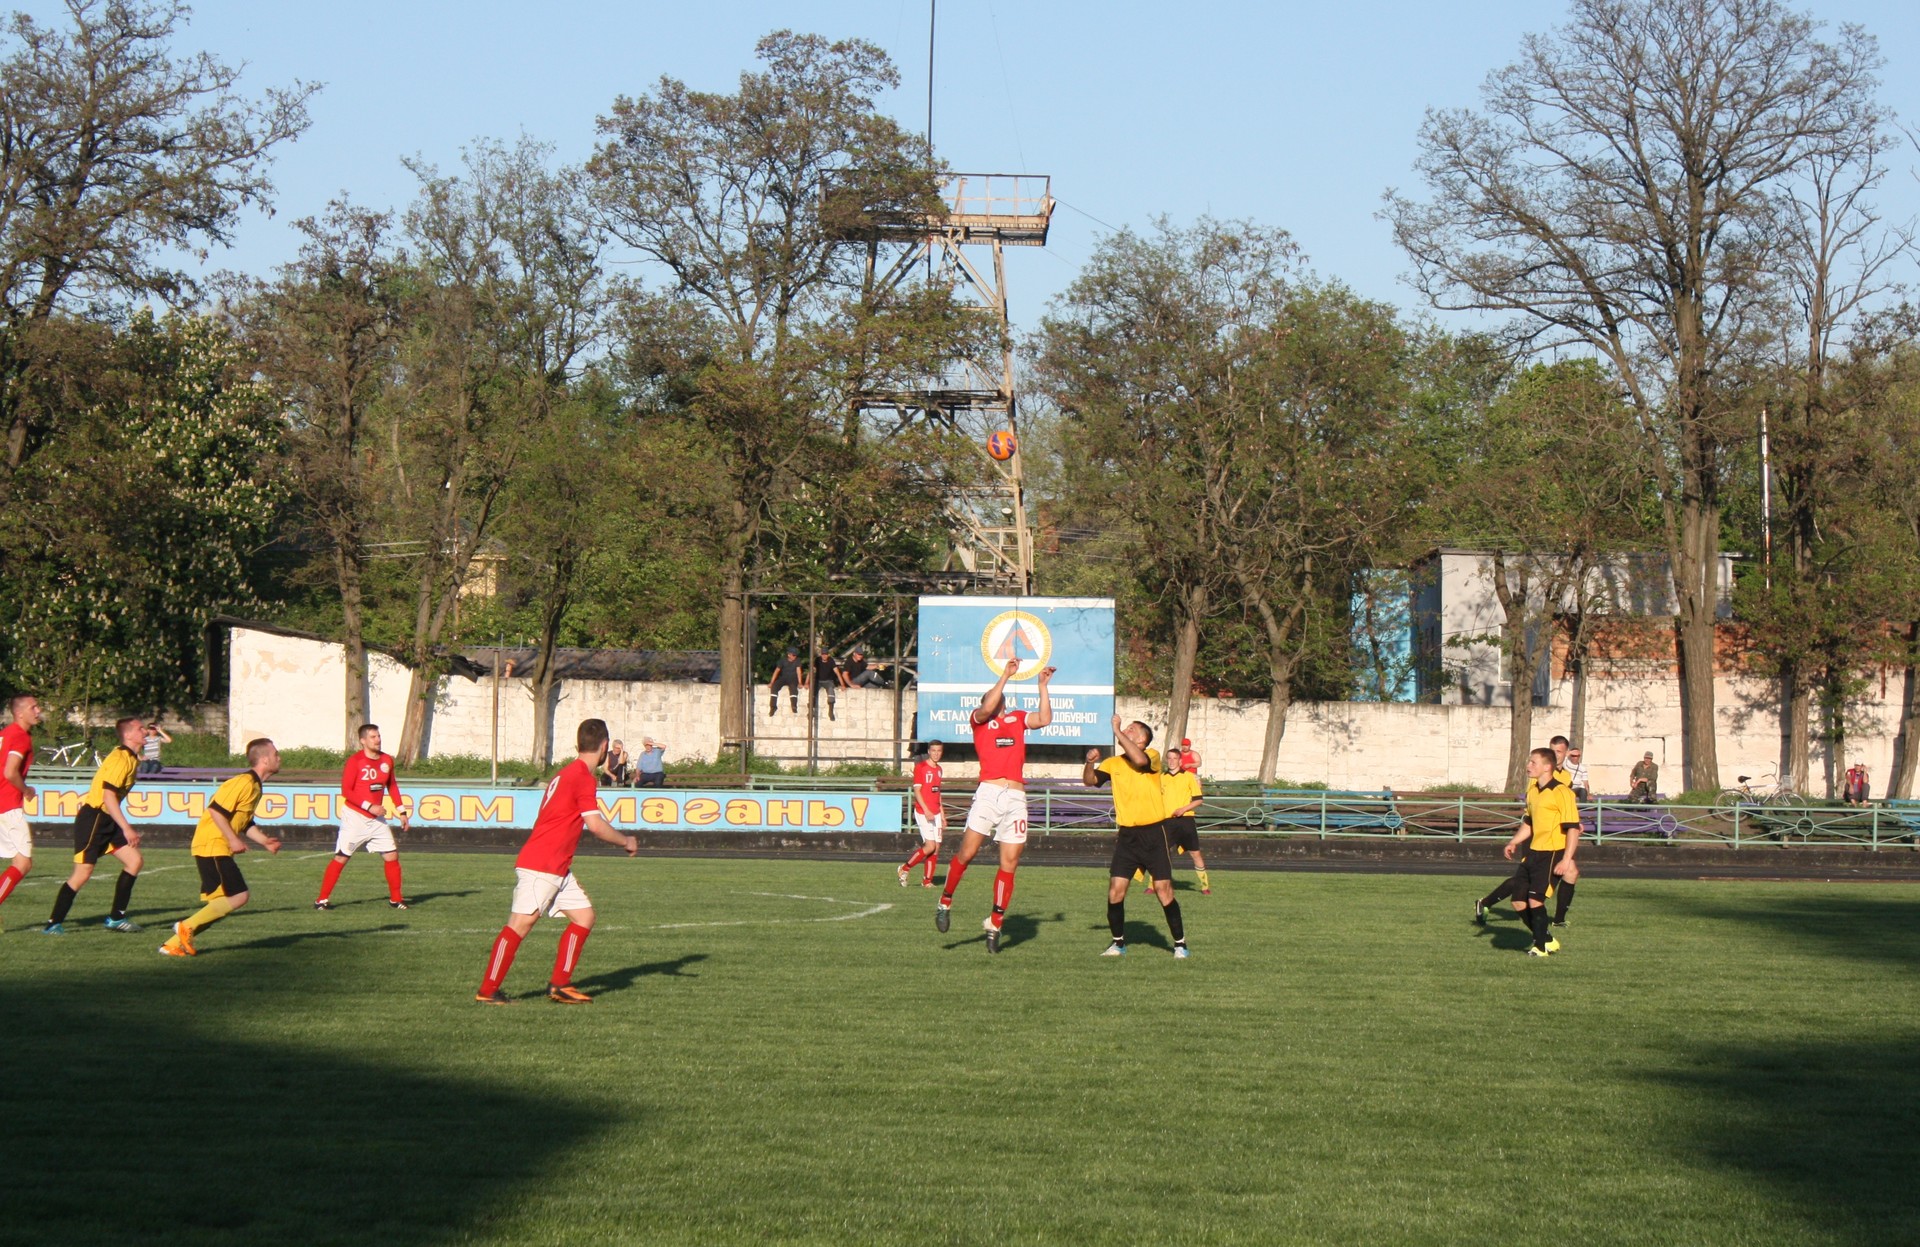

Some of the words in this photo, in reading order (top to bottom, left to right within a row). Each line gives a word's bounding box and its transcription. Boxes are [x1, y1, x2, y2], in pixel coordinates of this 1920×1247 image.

[960, 696, 1018, 708] ПРОКА
[1023, 697, 1075, 710] ТРУЩИХ
[1052, 711, 1098, 723] ДОБУВНОЇ
[1040, 725, 1081, 737] УКРАЇНИ
[361, 768, 377, 781] 20
[925, 773, 934, 784] 17
[126, 791, 514, 823] учснкам
[596, 796, 870, 828] магань!
[1013, 819, 1027, 834] 10
